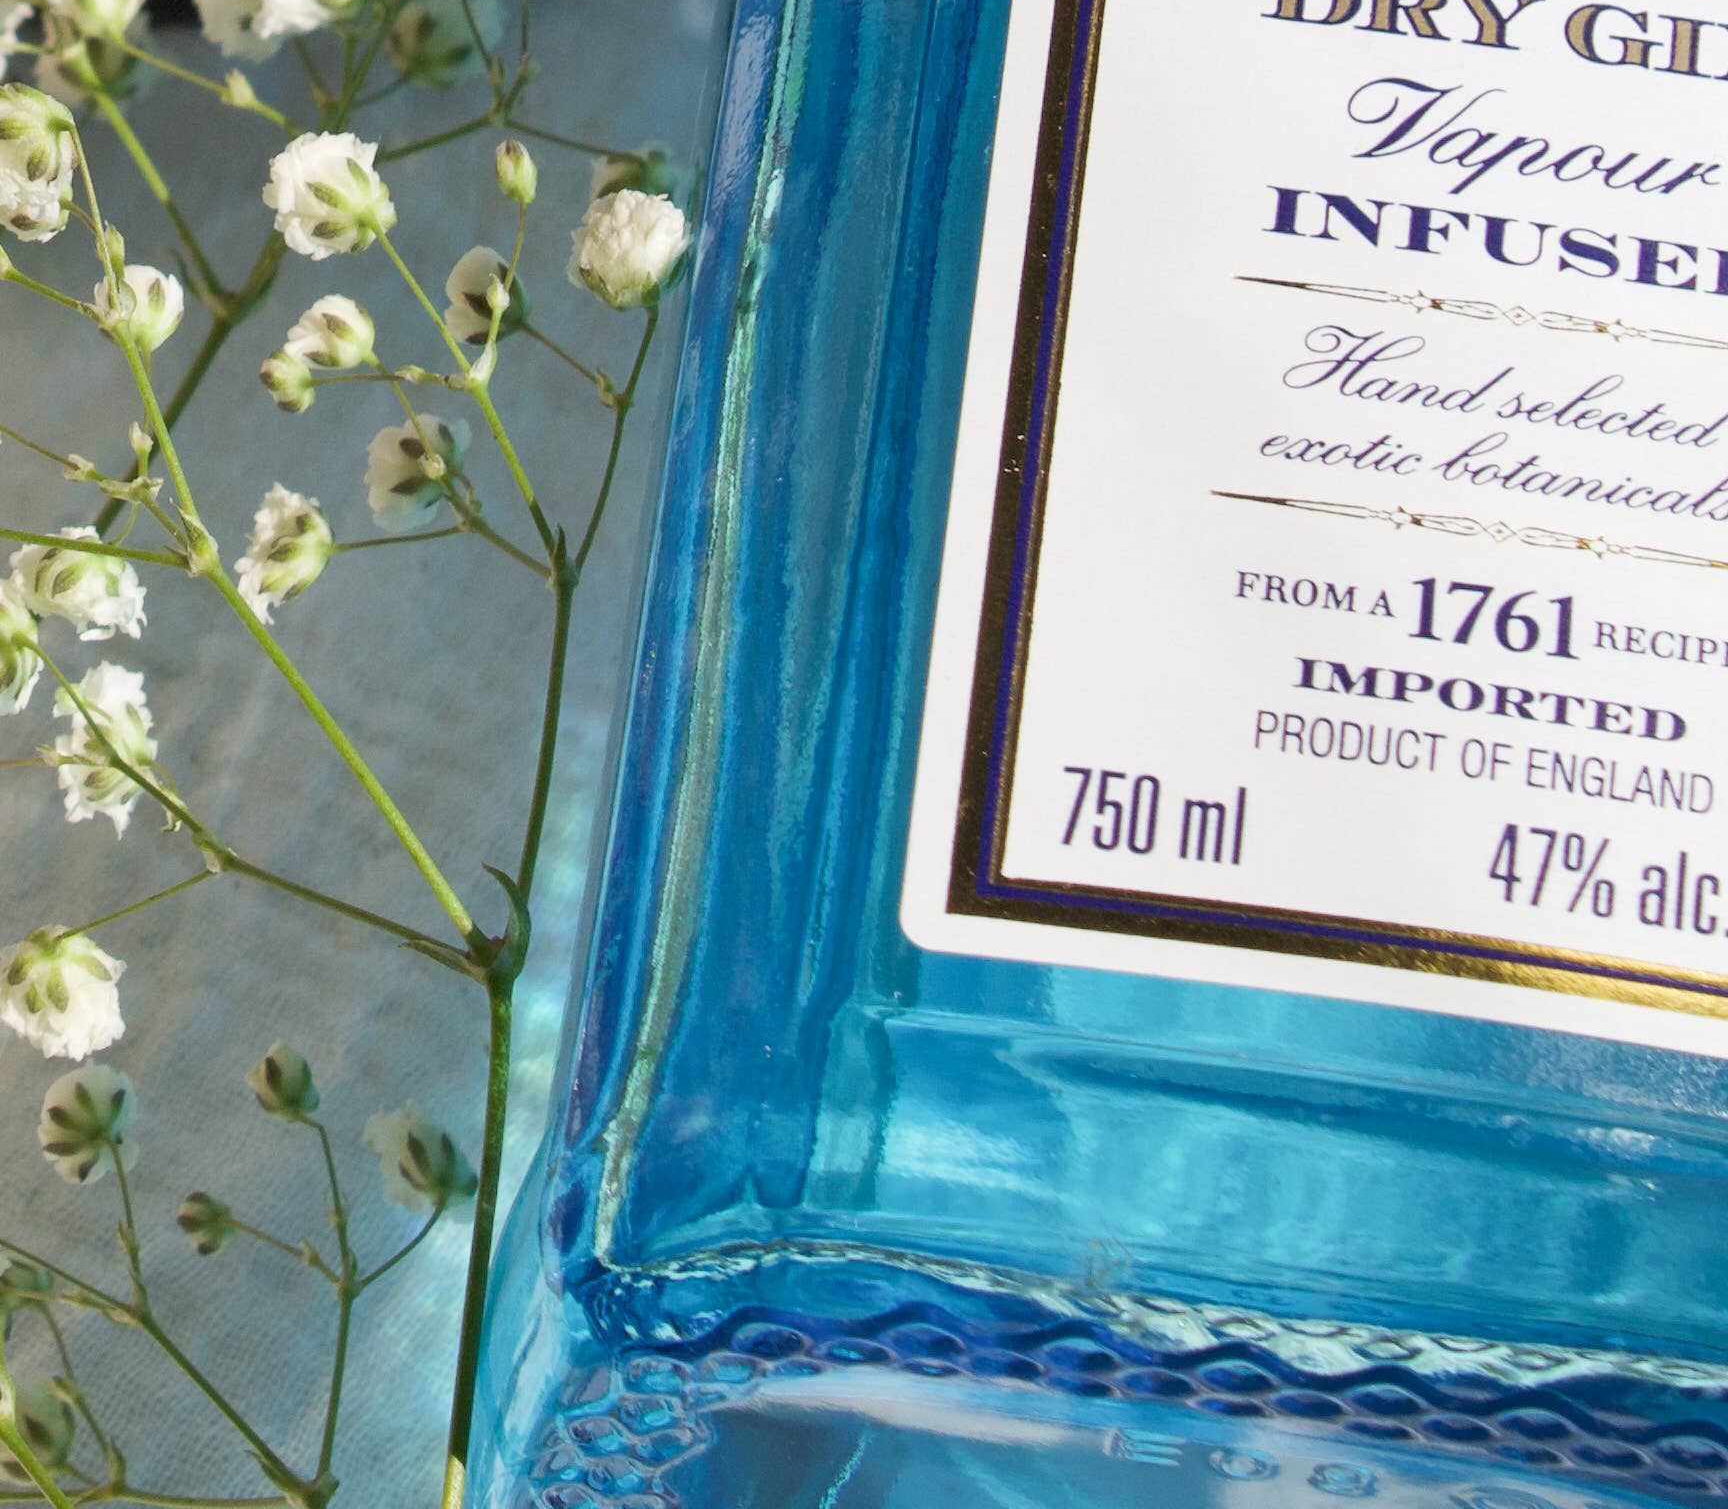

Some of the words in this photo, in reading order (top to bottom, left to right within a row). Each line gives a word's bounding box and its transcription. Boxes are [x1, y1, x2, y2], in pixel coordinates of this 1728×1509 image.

[1565, 3, 1728, 81] GI
[1347, 77, 1721, 195] Vapour
[1282, 325, 1515, 413] Hand
[1496, 374, 1728, 448] selected
[1258, 434, 1422, 476] exotic
[1234, 570, 1358, 613] FROM
[1368, 589, 1396, 619] A
[1409, 577, 1581, 661] 1761
[1292, 657, 1688, 743] IMPORTED
[1254, 709, 1448, 772] PRODUCT
[1460, 737, 1514, 781] OF
[1525, 746, 1715, 815] ENGLAND
[1060, 765, 1162, 856] 750
[1178, 786, 1248, 866] ml
[1489, 822, 1615, 919] 47%
